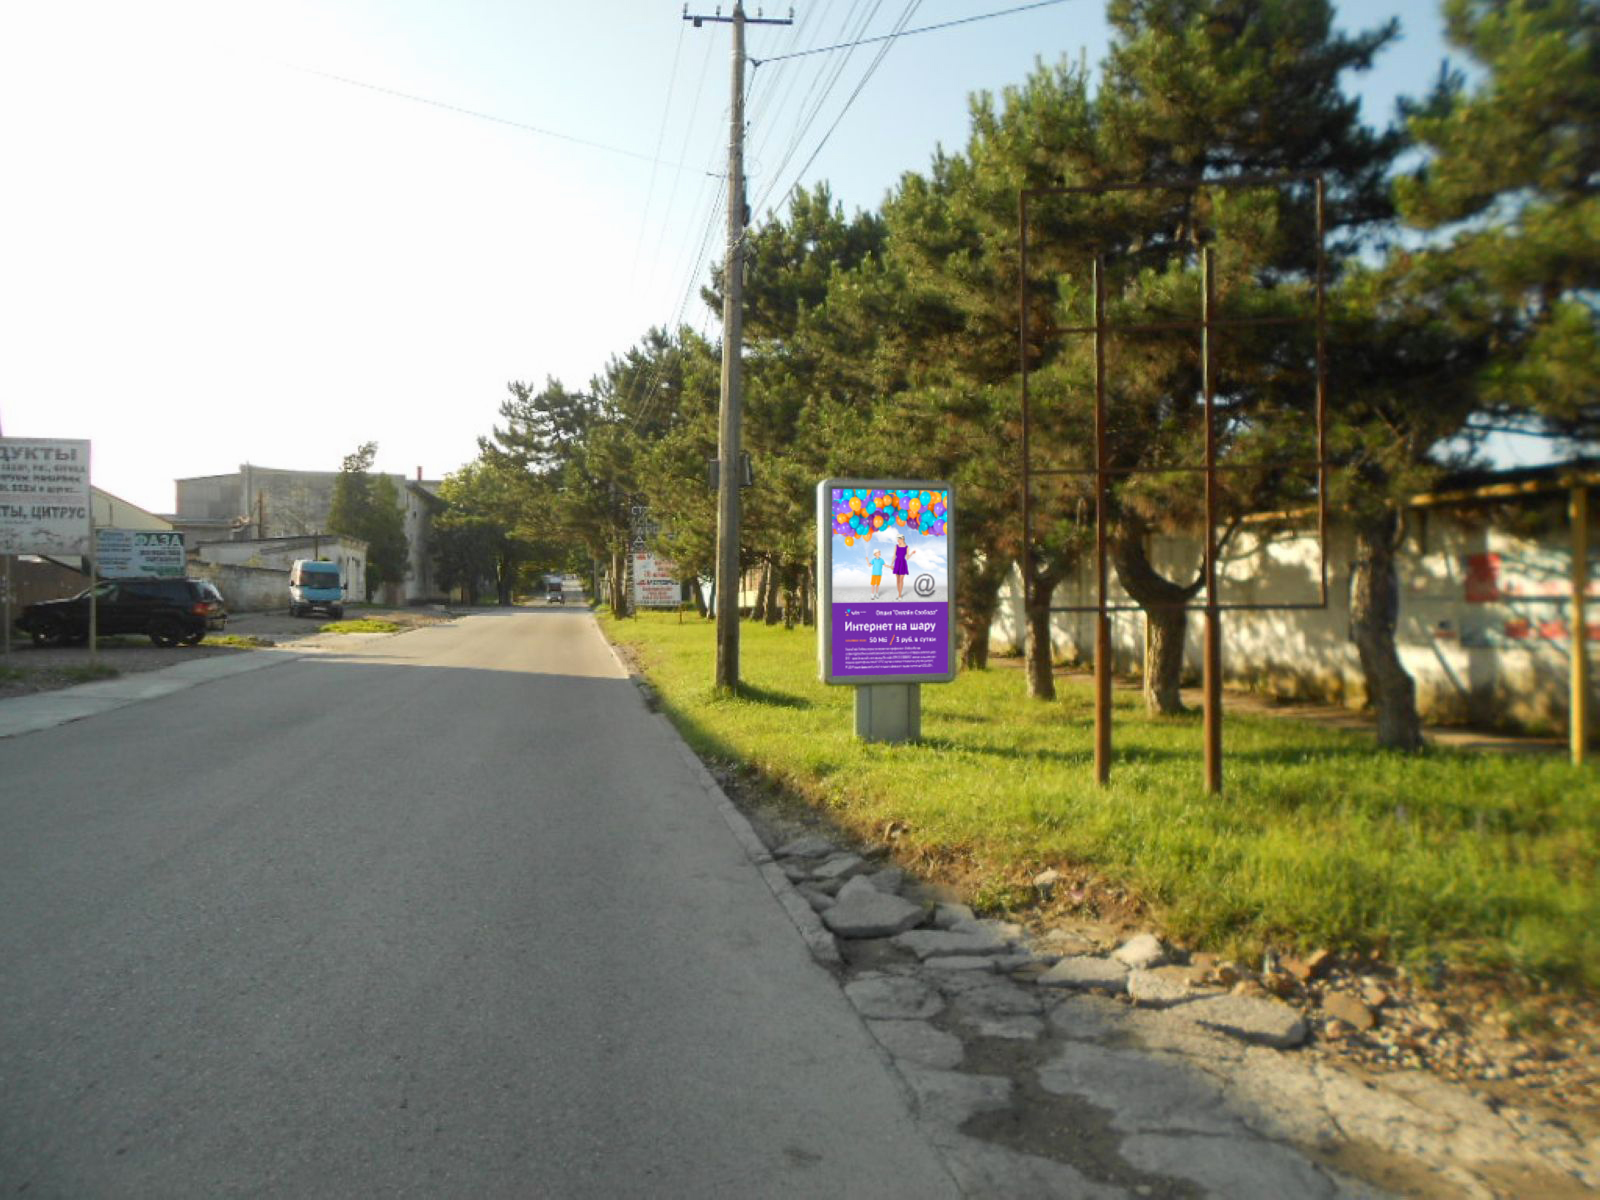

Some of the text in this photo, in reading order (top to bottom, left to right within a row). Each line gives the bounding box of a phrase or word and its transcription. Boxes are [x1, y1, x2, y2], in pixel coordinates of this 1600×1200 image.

[32, 506, 86, 520] ЦИТРУС
[844, 621, 936, 633] Интернет на шару
